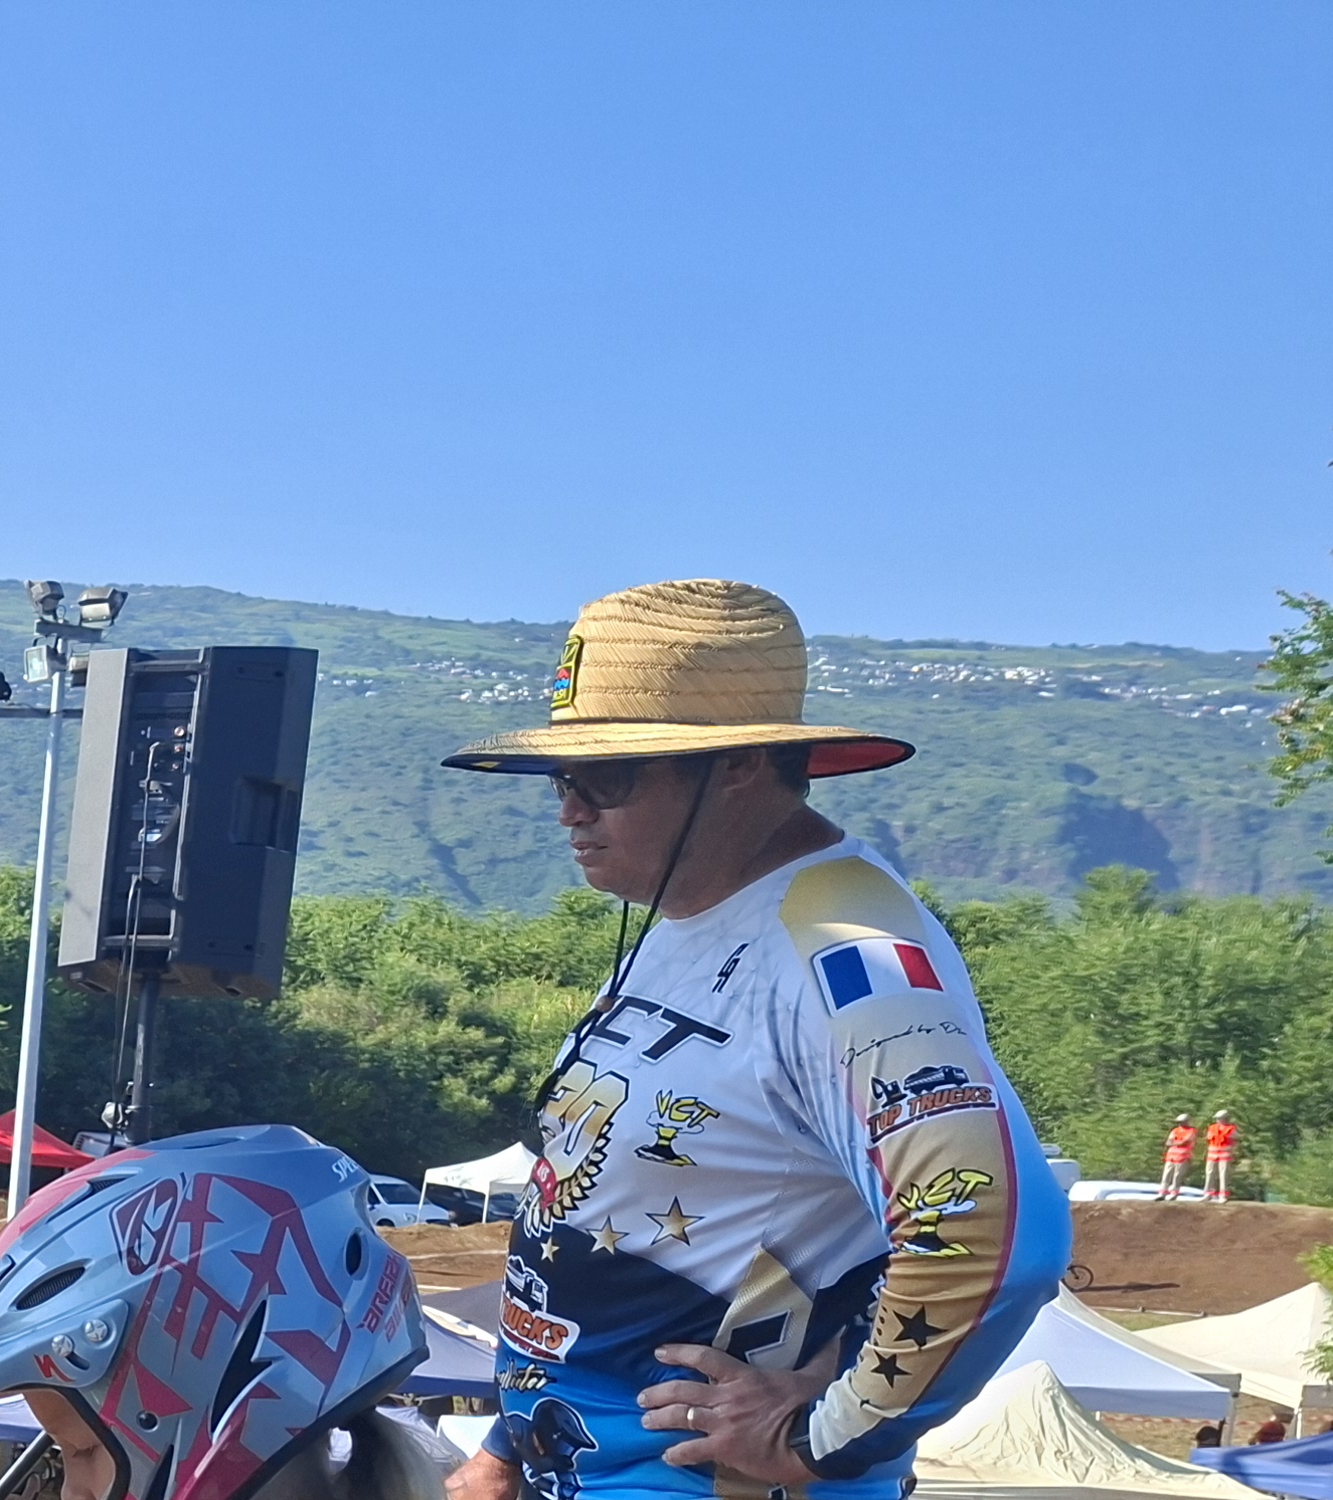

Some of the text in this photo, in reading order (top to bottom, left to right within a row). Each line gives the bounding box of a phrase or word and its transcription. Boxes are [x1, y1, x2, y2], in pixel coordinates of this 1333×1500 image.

[590, 995, 731, 1061] CT
[656, 1090, 721, 1127] VCT
[867, 1086, 994, 1136] TOP TRUCKS
[897, 1168, 994, 1212] VCT
